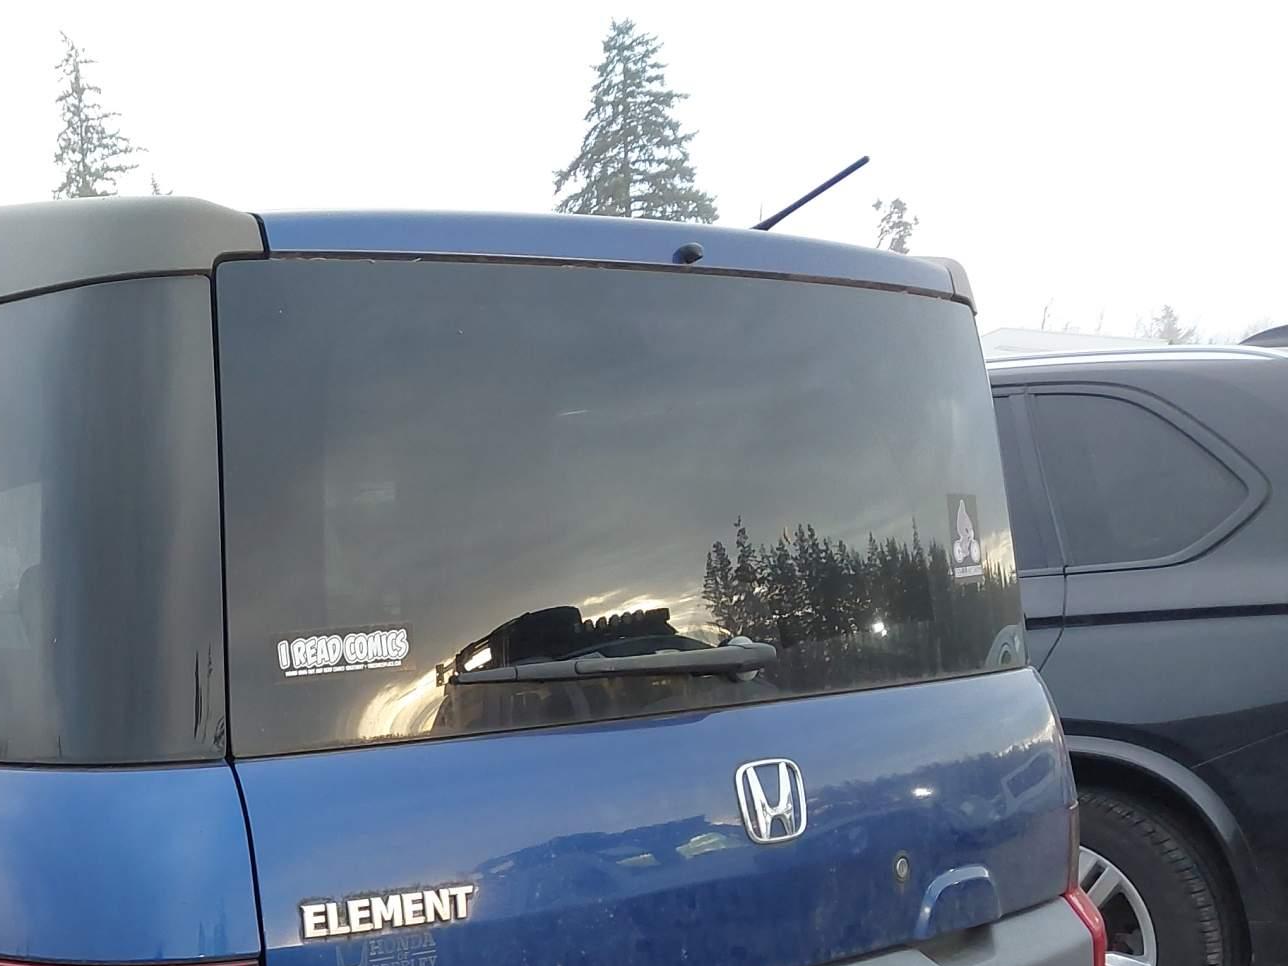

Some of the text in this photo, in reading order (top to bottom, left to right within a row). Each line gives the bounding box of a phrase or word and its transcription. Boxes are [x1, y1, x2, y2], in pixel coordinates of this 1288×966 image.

[277, 640, 290, 669] I
[291, 635, 343, 669] READ
[343, 629, 409, 664] COMICS
[300, 884, 474, 938] ELEMENT
[369, 933, 437, 956] HONDA
